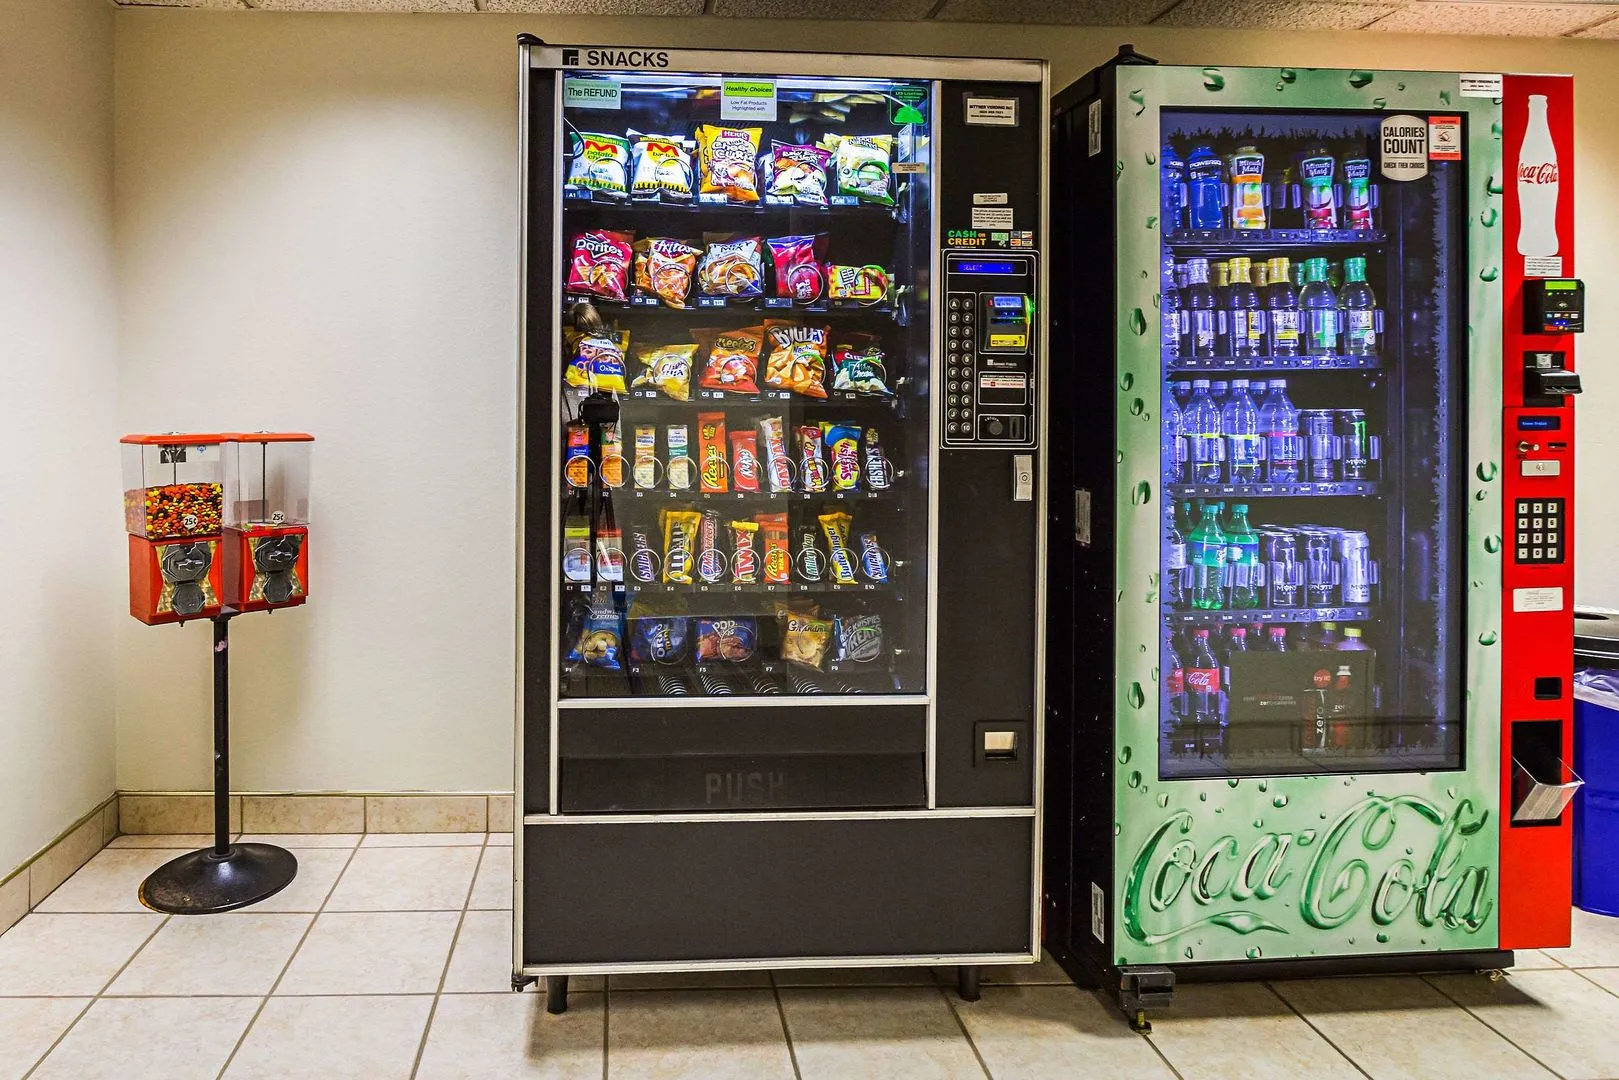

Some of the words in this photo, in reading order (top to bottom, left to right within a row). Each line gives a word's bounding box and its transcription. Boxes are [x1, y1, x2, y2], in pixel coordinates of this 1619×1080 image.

[587, 50, 669, 68] SNACKS
[568, 88, 582, 96] The
[584, 88, 618, 98] REFUND
[1383, 126, 1424, 138] CALORIES
[1384, 139, 1424, 154] COUNT
[576, 239, 624, 258] Doritos
[703, 444, 718, 487] Reese's
[838, 441, 852, 480] Swedish
[633, 532, 652, 578] SNICKERS
[736, 530, 754, 580] TWIX
[1188, 672, 1210, 685] Cola
[706, 772, 784, 804] PUSH
